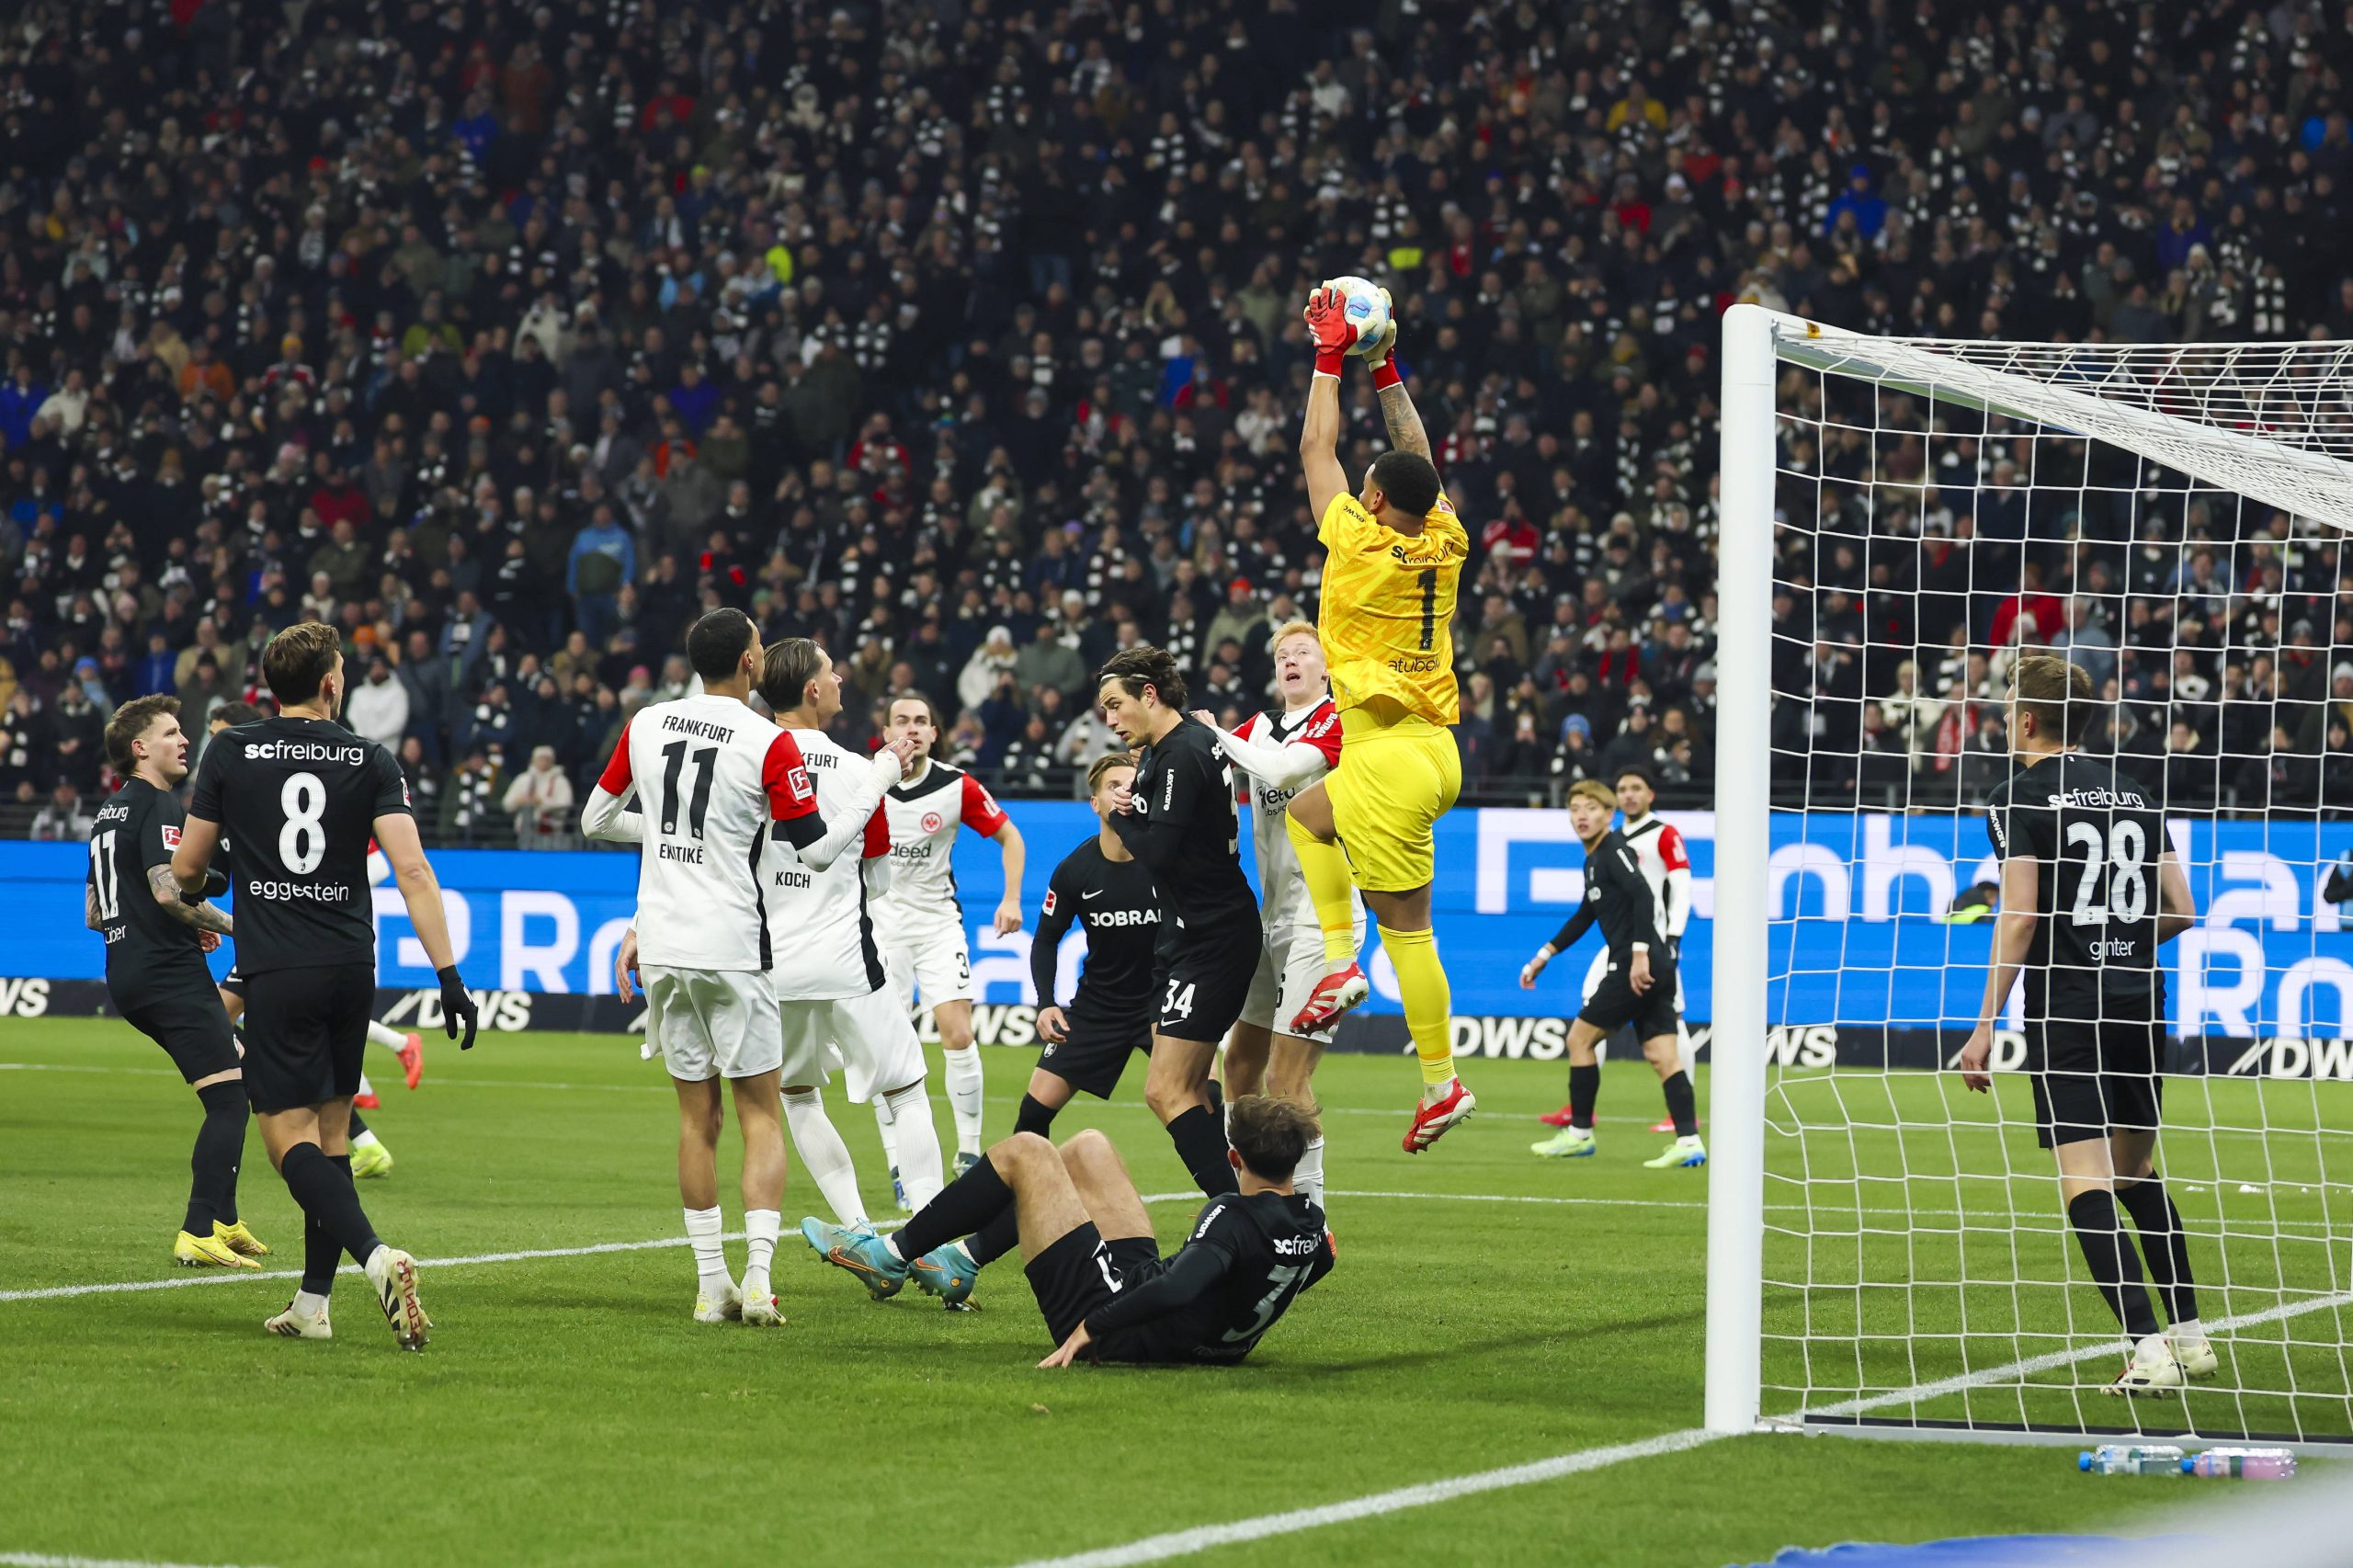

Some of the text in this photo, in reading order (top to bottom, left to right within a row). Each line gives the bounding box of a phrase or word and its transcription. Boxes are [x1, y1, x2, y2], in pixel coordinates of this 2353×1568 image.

[1416, 568, 1438, 651] 1
[662, 715, 734, 744] FRANKFURT
[244, 740, 364, 766] scfreiburg
[661, 740, 719, 841] 11
[278, 771, 326, 875] 8
[889, 842, 932, 858] deed
[775, 871, 811, 889] KOCH
[2066, 819, 2147, 926] 28
[249, 880, 349, 903] eggestein
[1089, 908, 1162, 927] JOBRA
[2089, 937, 2136, 960] gnter
[956, 952, 969, 979] 3
[1161, 979, 1196, 1019] 34
[1450, 1017, 1566, 1061] DWS
[2269, 1037, 2353, 1081] DW
